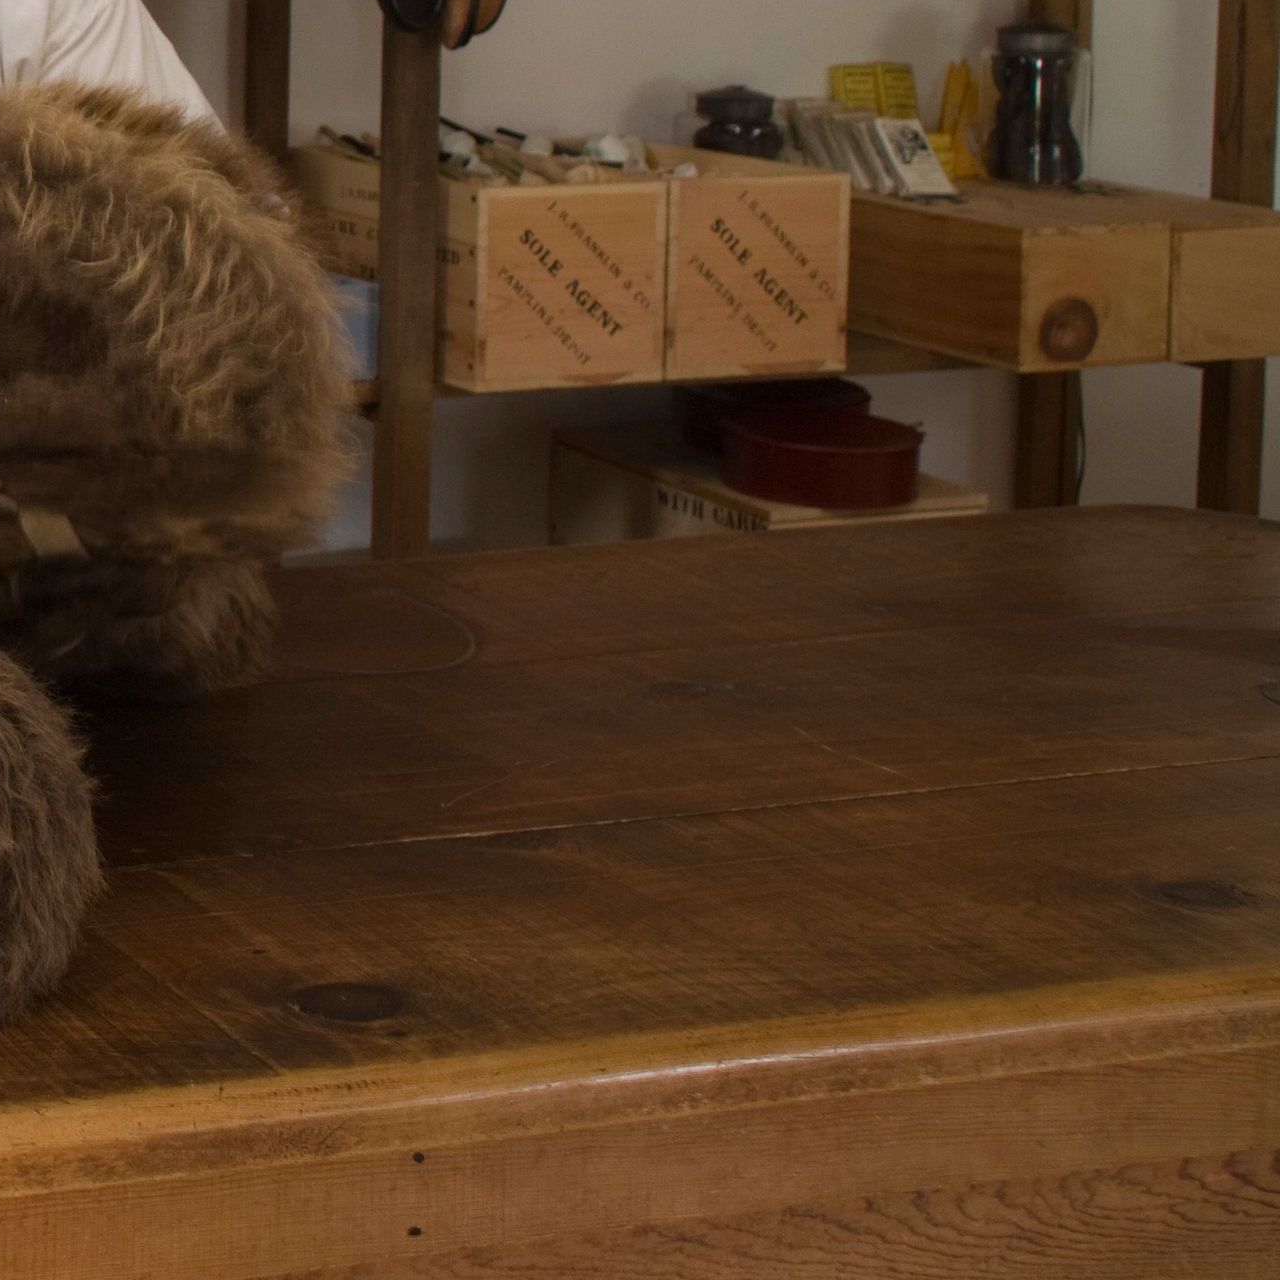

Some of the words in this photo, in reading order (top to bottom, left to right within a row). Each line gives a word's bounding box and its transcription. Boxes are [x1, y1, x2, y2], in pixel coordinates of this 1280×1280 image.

[519, 228, 564, 278] SOLE
[565, 278, 624, 337] AGENT
[709, 218, 753, 267] SOLE
[754, 267, 809, 326] AGENT
[552, 325, 592, 367] DEPOT
[743, 313, 780, 354] DEPOT
[657, 488, 705, 521] WITH
